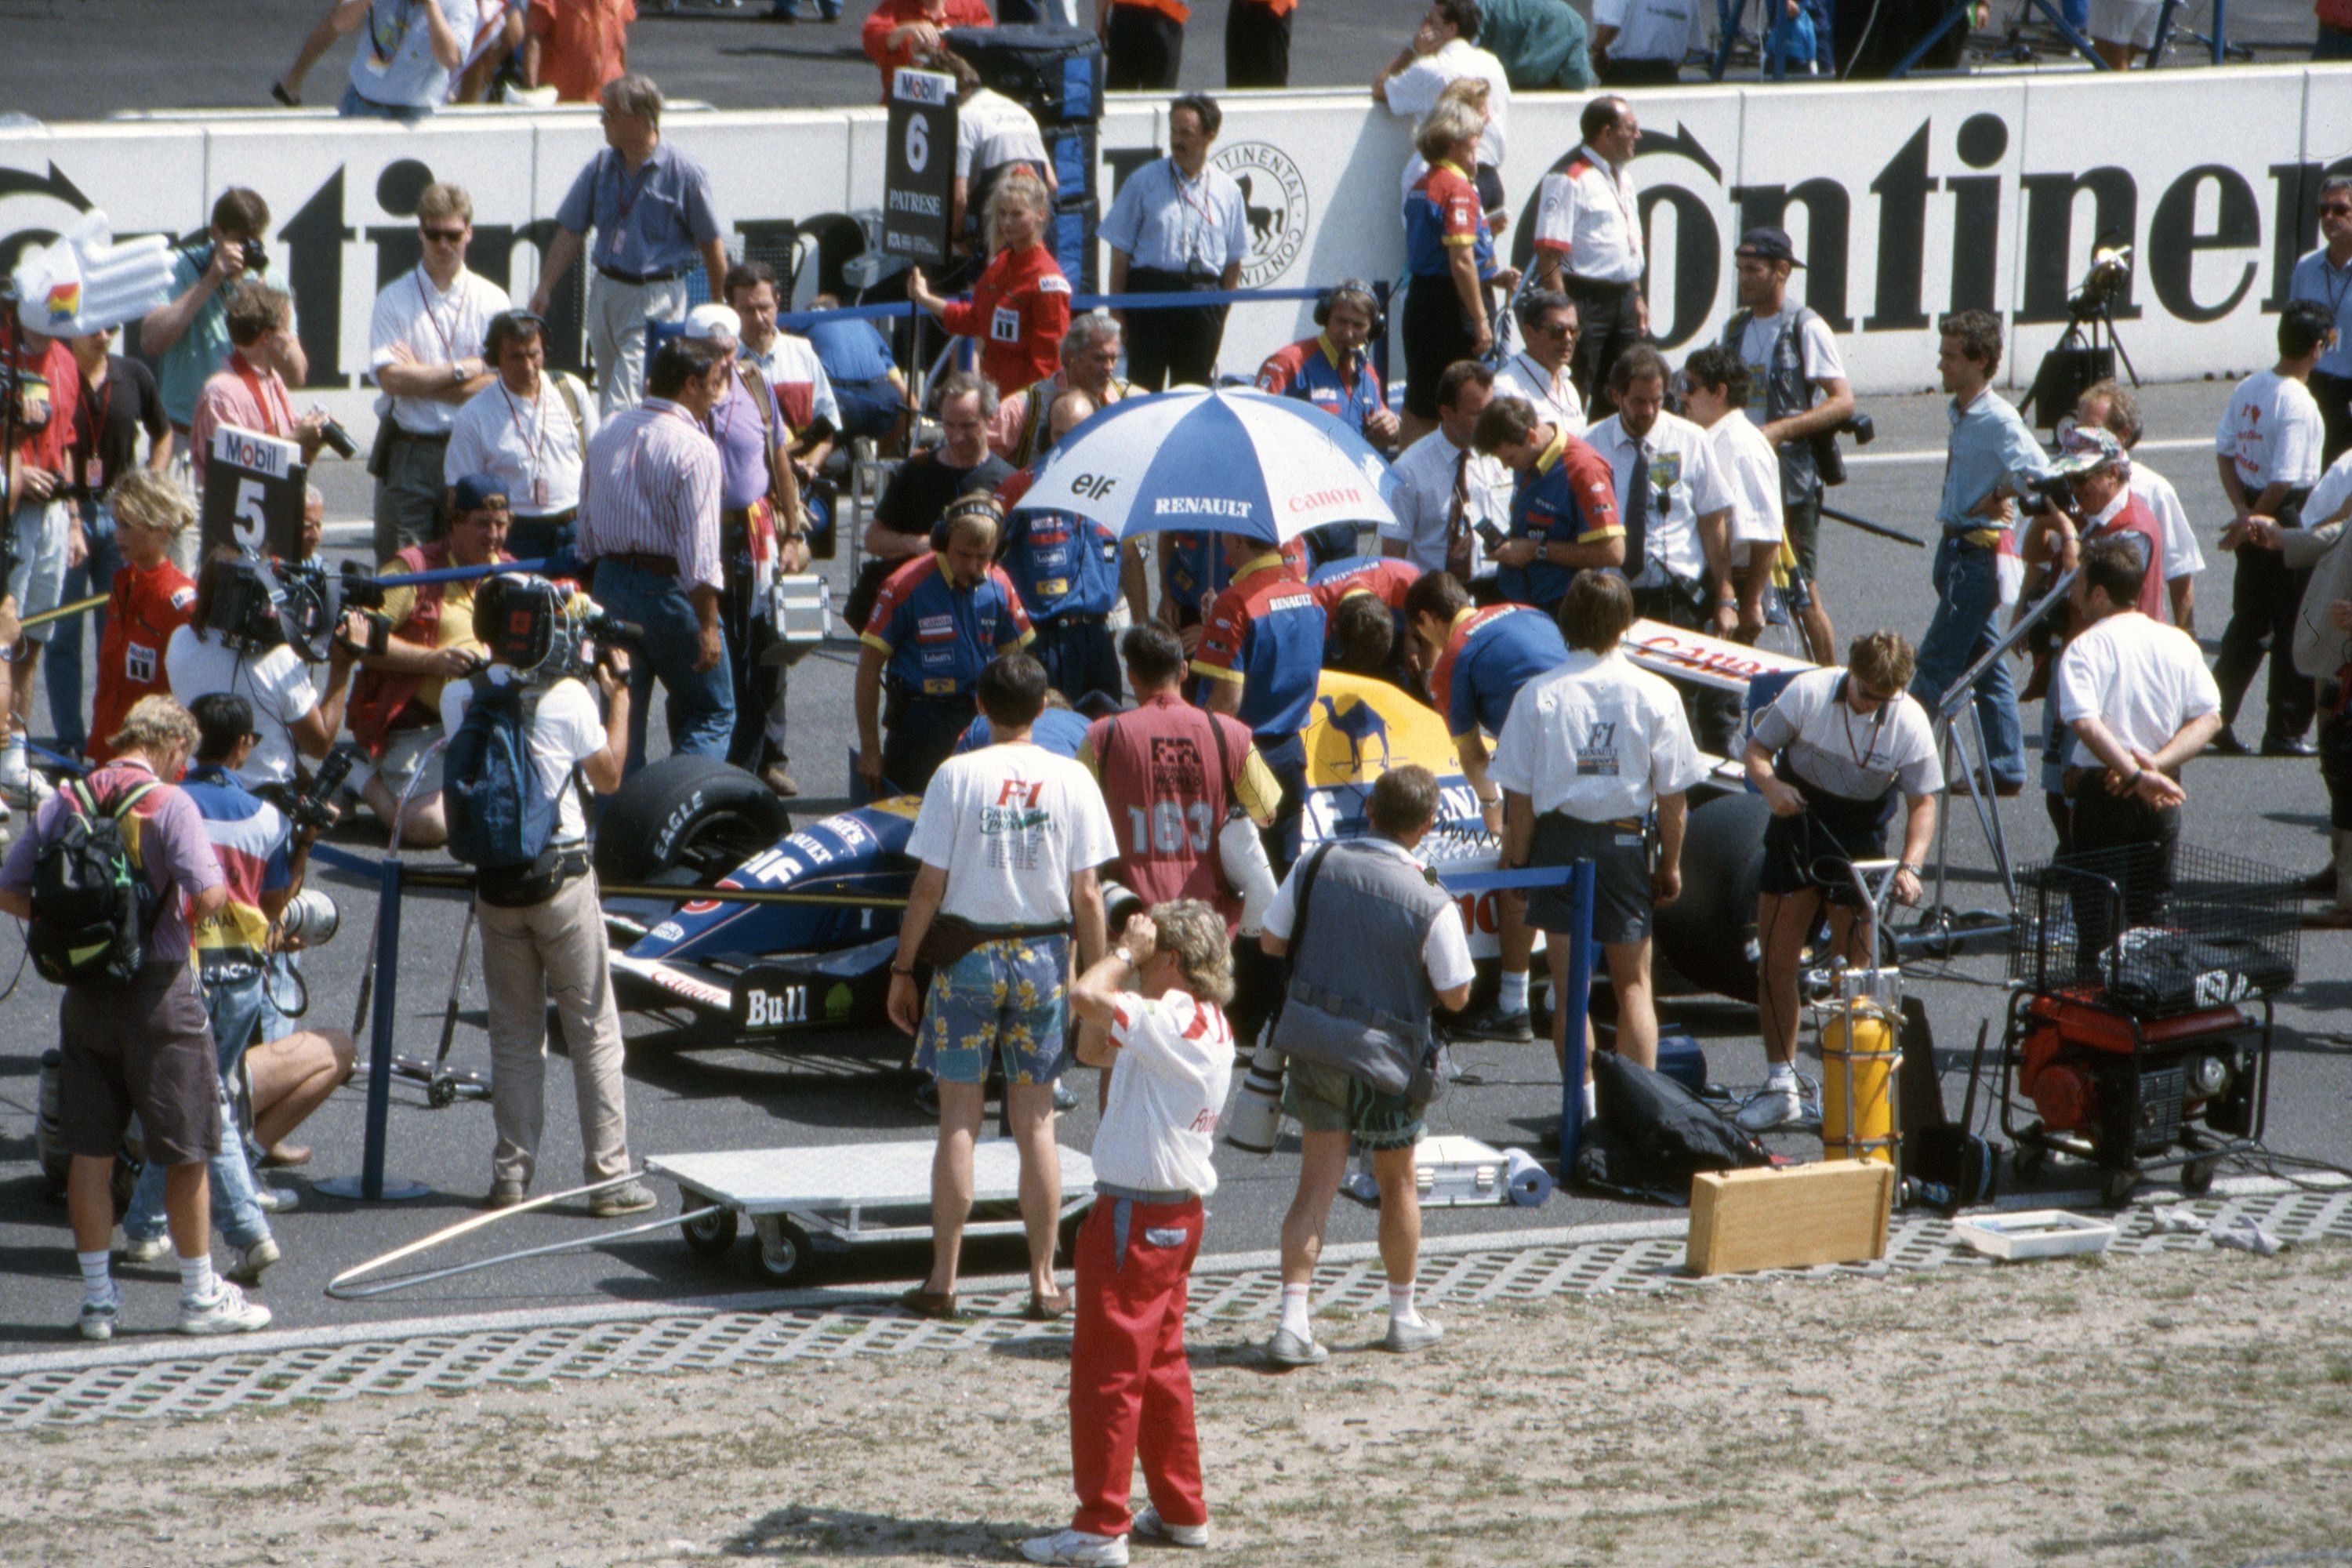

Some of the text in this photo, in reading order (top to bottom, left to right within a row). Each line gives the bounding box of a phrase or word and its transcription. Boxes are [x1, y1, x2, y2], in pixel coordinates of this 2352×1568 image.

[902, 74, 938, 100] Mobil
[906, 112, 929, 173] 6
[889, 188, 941, 216] PATRESE
[226, 432, 278, 473] Mobil
[1071, 473, 1116, 501] elf
[1288, 486, 1363, 514] Canon
[233, 477, 266, 548] 5
[1154, 495, 1254, 518] RENAULT
[1269, 592, 1313, 612] RENAULT
[1588, 721, 1616, 747] F1
[996, 779, 1044, 808] F1
[653, 789, 704, 861] EAGLE
[1127, 800, 1214, 855] 163
[746, 985, 808, 1027] Bull
